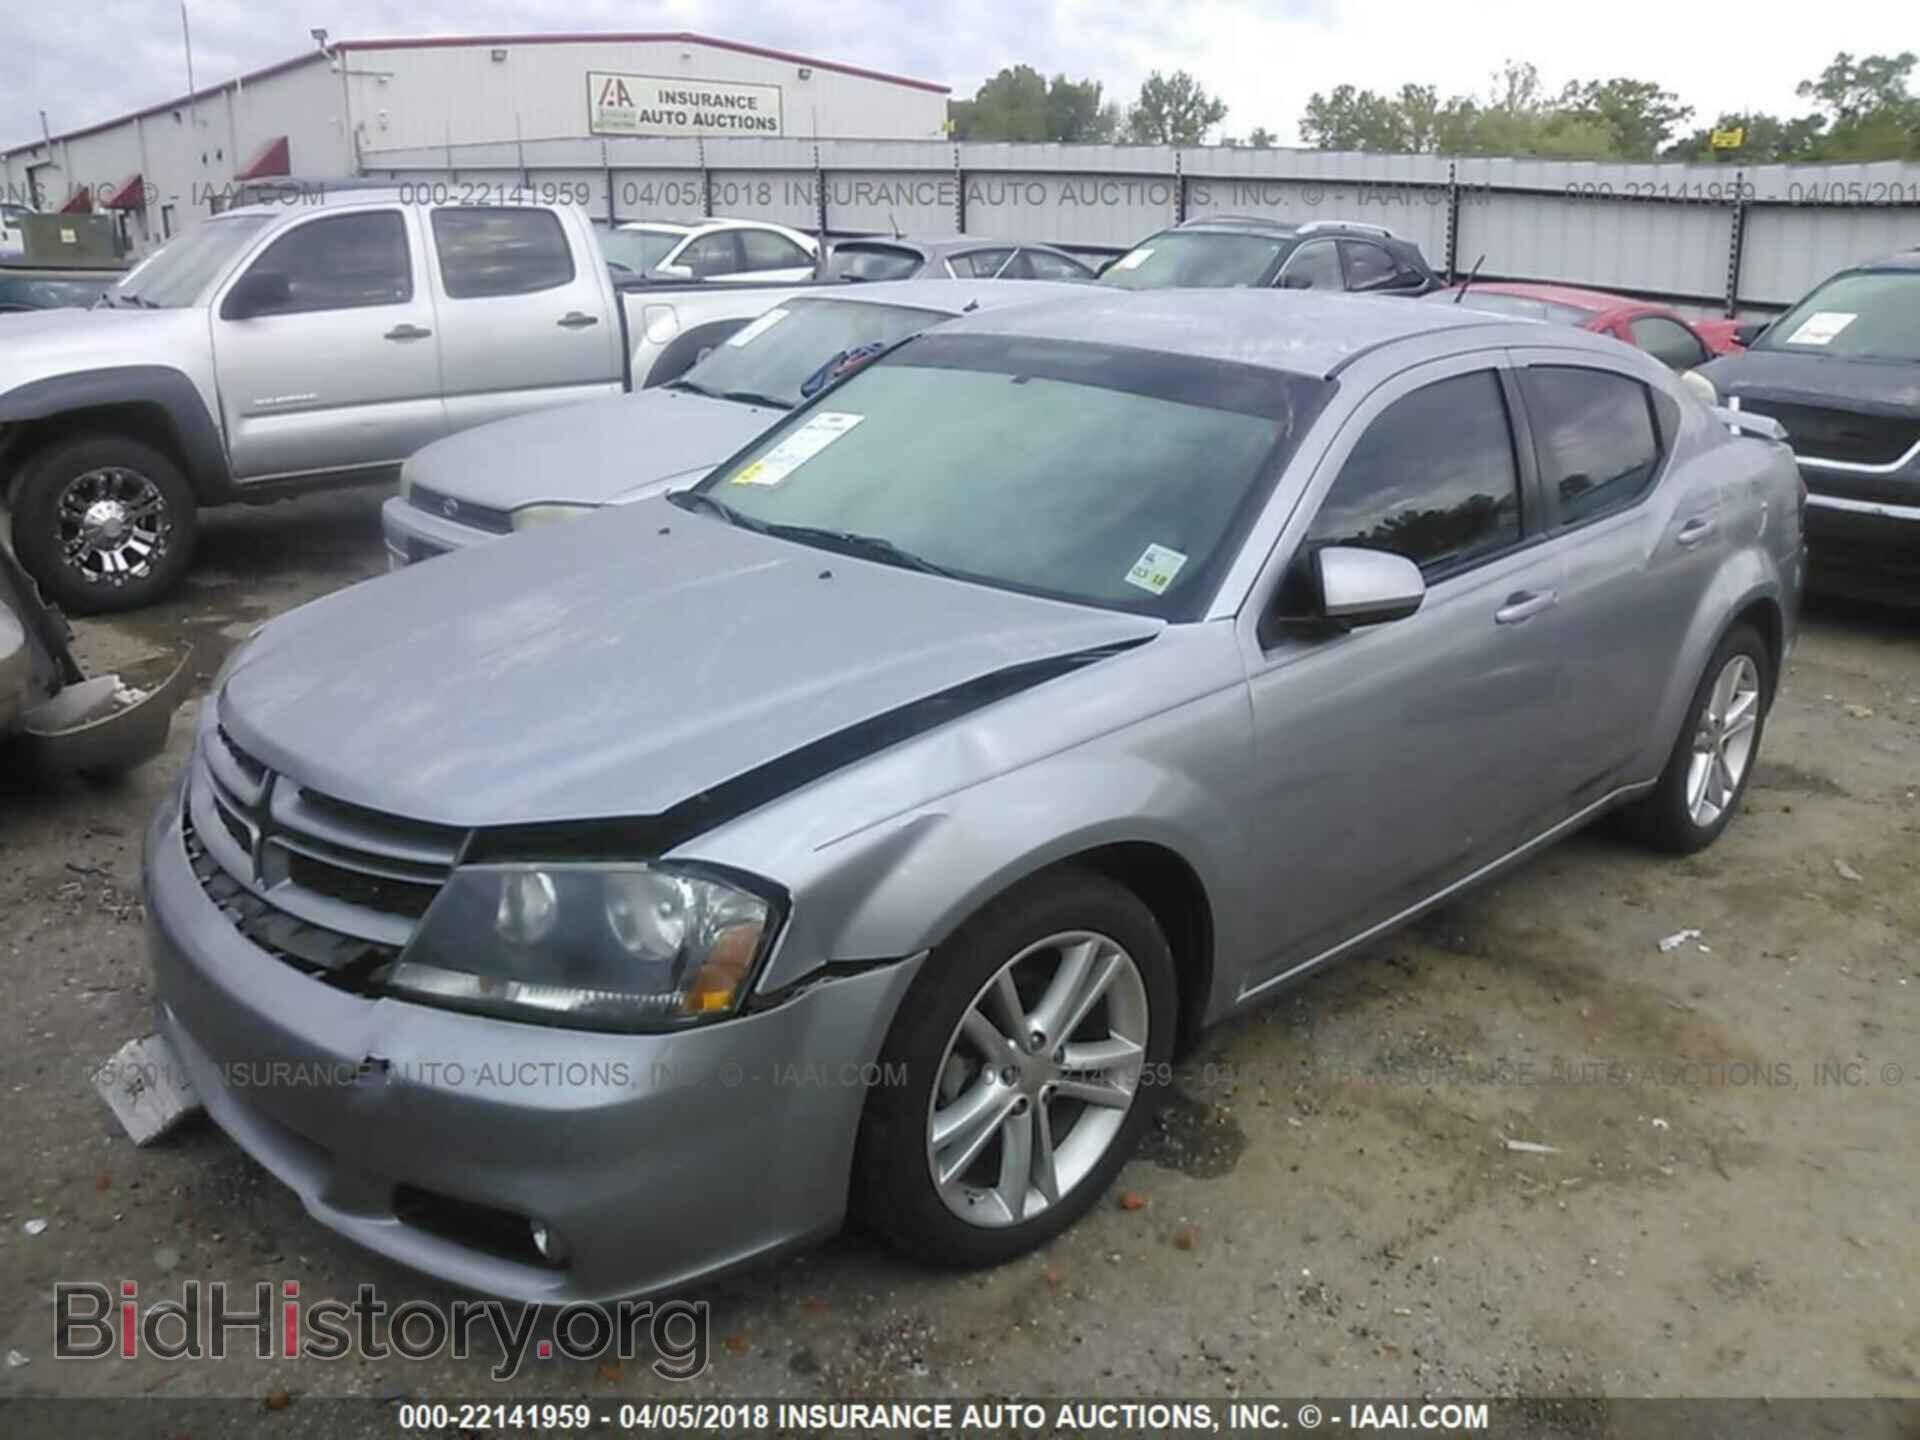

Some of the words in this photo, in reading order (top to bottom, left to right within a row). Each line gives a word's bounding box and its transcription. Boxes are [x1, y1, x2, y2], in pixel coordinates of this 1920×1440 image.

[658, 90, 757, 110] INSURANCE
[640, 109, 687, 125] AUTO
[692, 112, 777, 131] AUCTIONS
